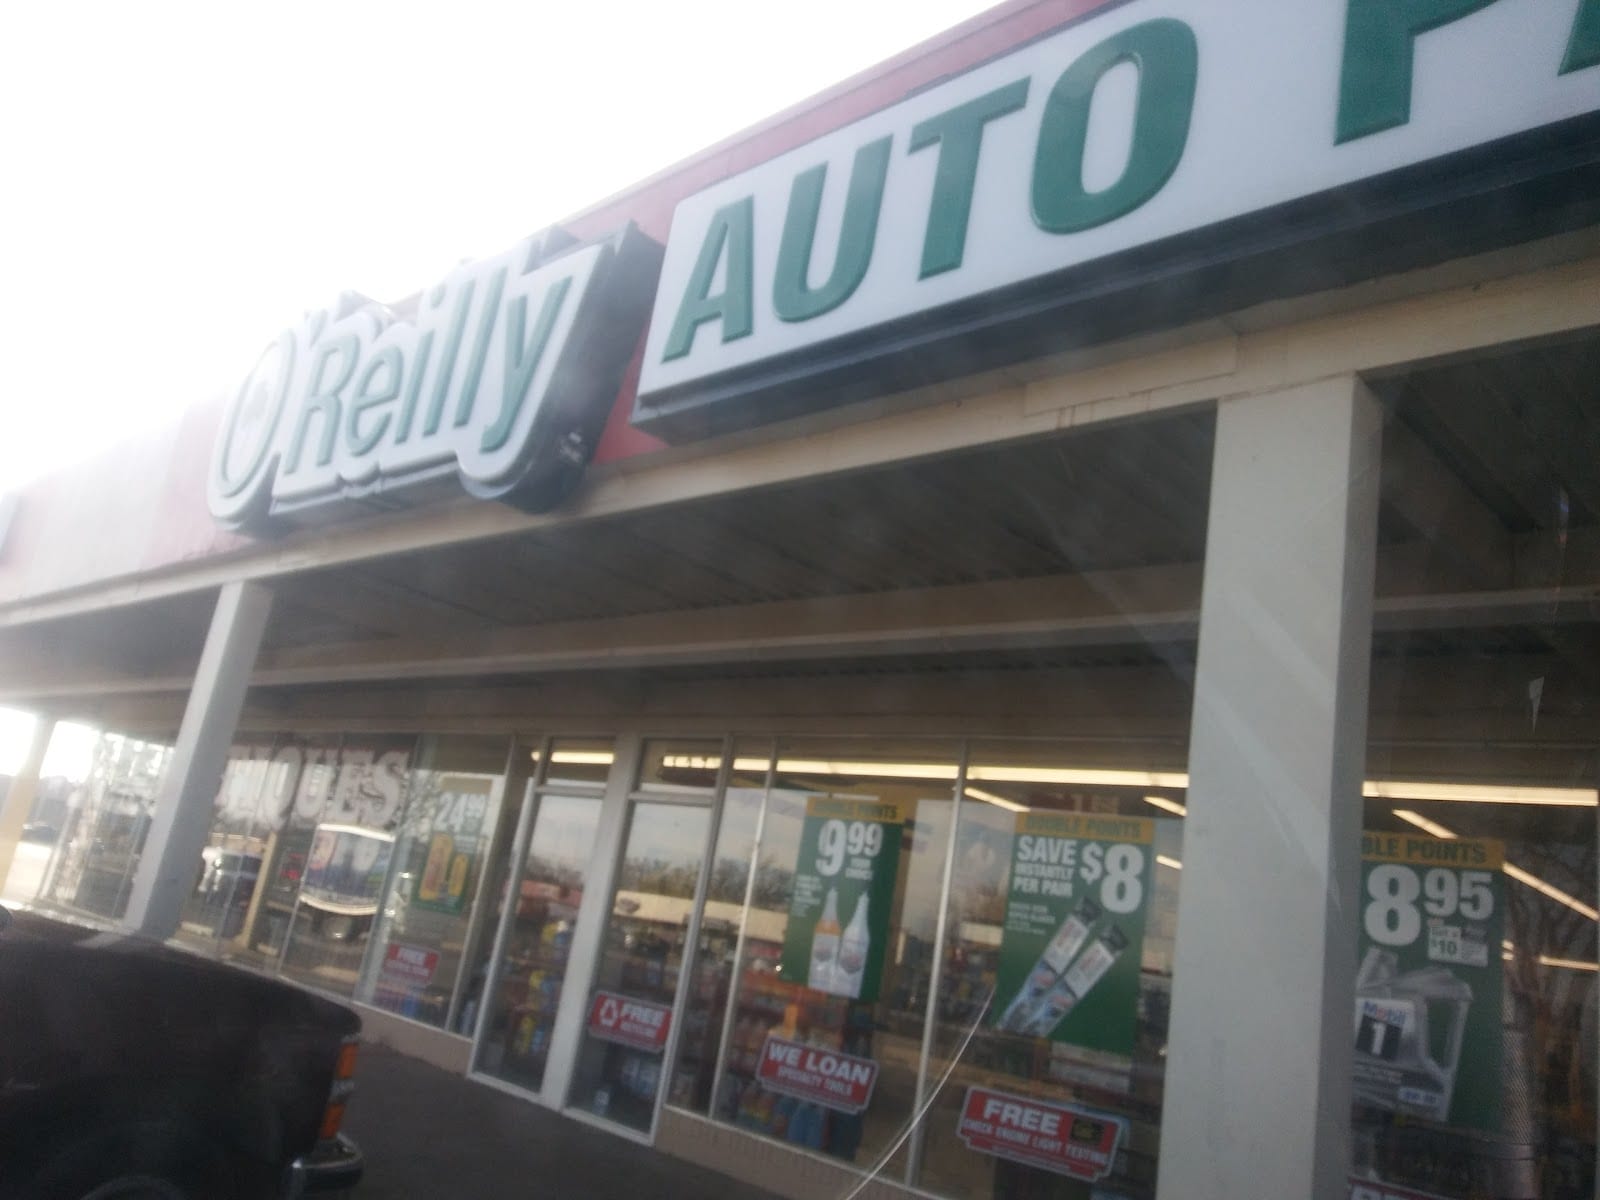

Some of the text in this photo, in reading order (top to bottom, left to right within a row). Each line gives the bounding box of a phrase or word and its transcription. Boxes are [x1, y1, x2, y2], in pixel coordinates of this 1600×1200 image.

[662, 16, 1198, 362] AUTO
[220, 266, 573, 497] O'Reilly
[1017, 835, 1077, 865] SAVE
[1407, 839, 1487, 863] POINTS
[1014, 862, 1074, 880] INSTANTLY
[1013, 877, 1073, 897] PER PAIR
[620, 1002, 666, 1026] FREE
[1364, 1001, 1407, 1025] Mobil
[1371, 1021, 1387, 1055] 1
[768, 1042, 872, 1086] WE LOAN
[983, 1098, 1061, 1136] FREE
[1031, 1134, 1063, 1152] LIGHT
